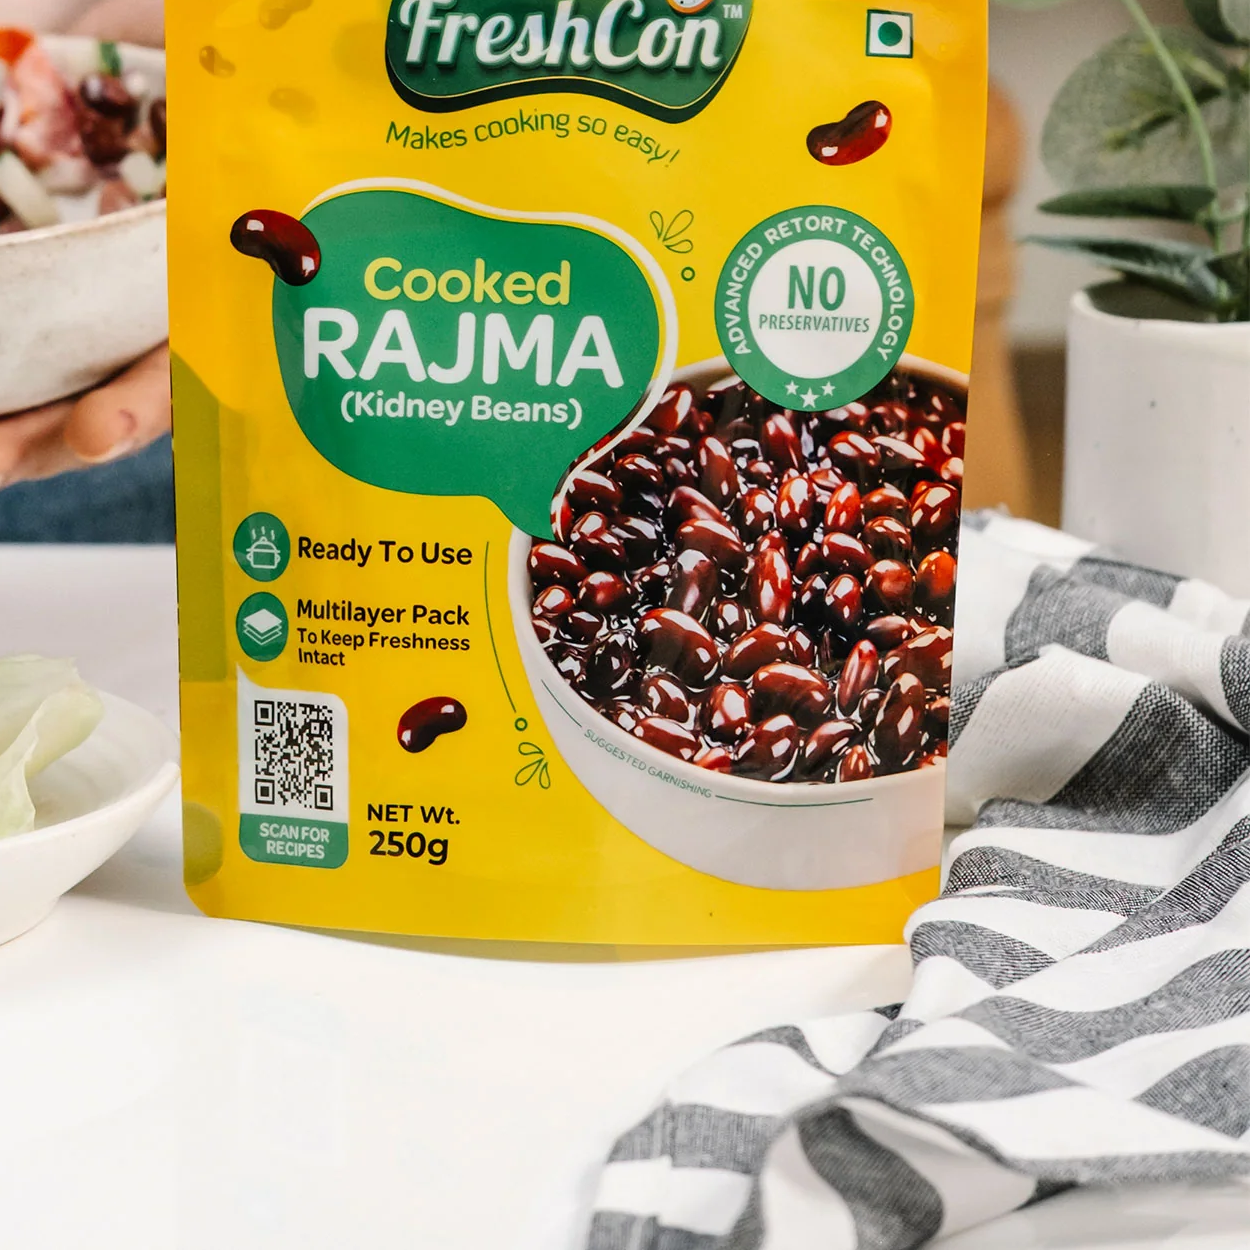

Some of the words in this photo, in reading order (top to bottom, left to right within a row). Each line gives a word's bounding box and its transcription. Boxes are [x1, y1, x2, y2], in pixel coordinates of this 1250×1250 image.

[385, 120, 467, 150] Makes
[475, 108, 570, 142] cooking
[578, 114, 607, 137] so
[614, 123, 681, 168] easy!
[363, 256, 571, 306] Cooked
[724, 241, 764, 356] ADVANCED
[764, 215, 848, 245] RETORT
[851, 225, 906, 362] TECHNOLOGY
[787, 264, 846, 312] NO
[758, 313, 871, 333] PRESERVATIVES
[303, 306, 625, 389] RAJMA
[340, 389, 465, 427] (Kidney
[470, 395, 583, 430] Beans)
[298, 536, 372, 568] Ready
[378, 540, 414, 563] To
[421, 542, 473, 565] Use
[296, 598, 406, 628] Multilayer
[412, 604, 470, 626] Pack
[297, 627, 317, 645] To
[321, 629, 365, 651] Keep
[369, 631, 471, 651] Freshness
[298, 647, 346, 667] Intact
[584, 728, 647, 771] SUGGESTED
[647, 765, 713, 798] GARNISHING
[367, 803, 413, 823] NET
[420, 805, 461, 825] Wt.
[259, 822, 300, 841] SCAN
[301, 826, 330, 843] FOR
[266, 840, 326, 859] RECIPES
[368, 829, 449, 866] 250g
